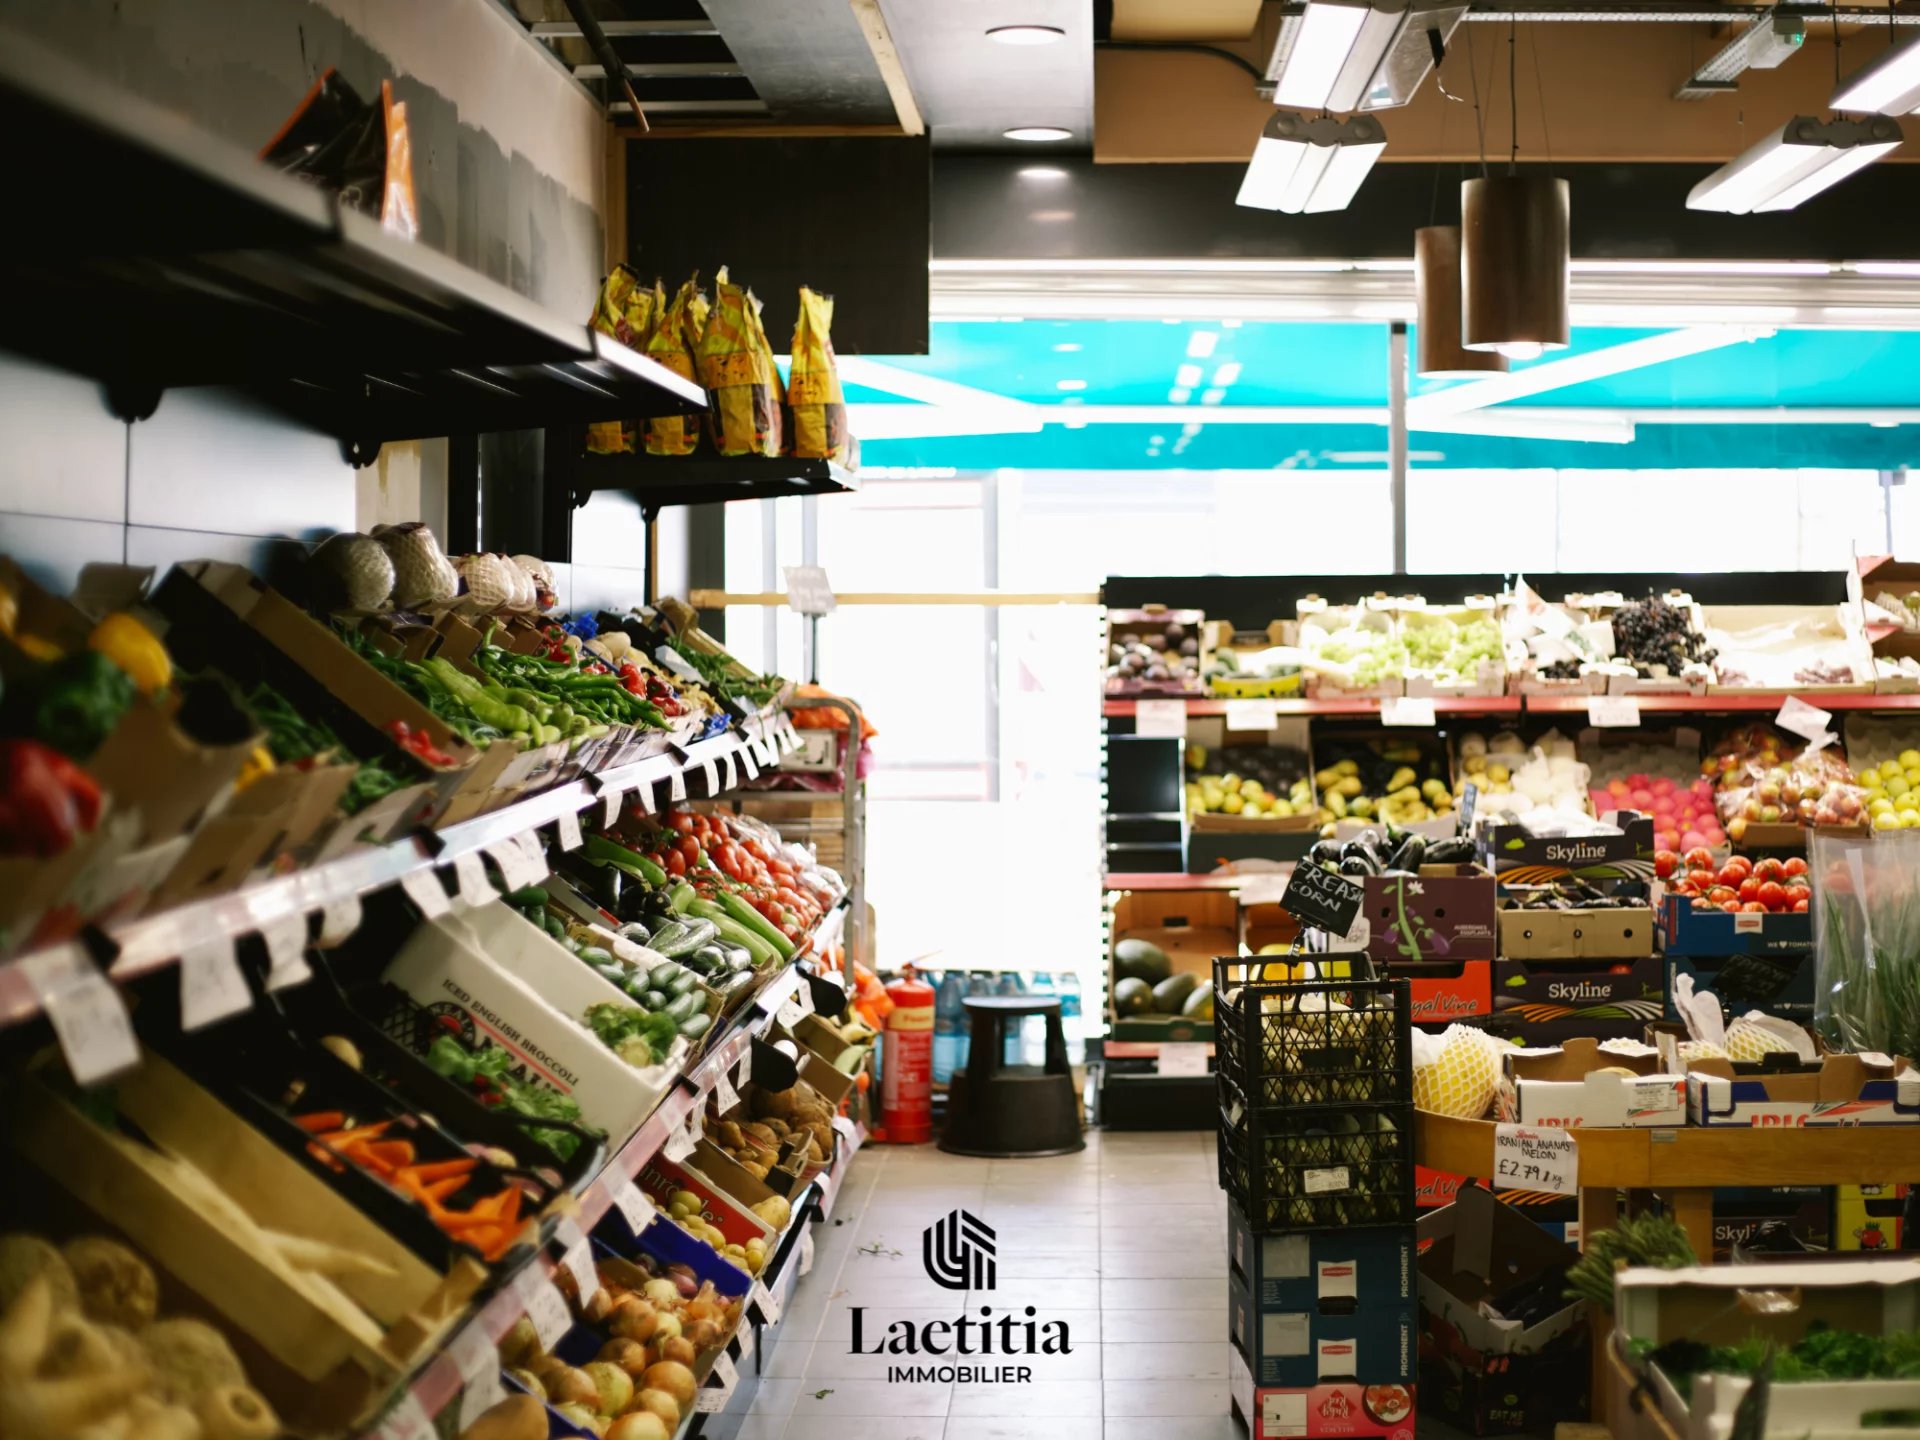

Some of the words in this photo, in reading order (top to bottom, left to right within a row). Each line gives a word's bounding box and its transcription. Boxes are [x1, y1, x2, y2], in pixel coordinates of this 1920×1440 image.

[1546, 842, 1607, 862] Skyline
[1297, 860, 1364, 902] FREASH
[1289, 881, 1342, 911] CORN
[1411, 992, 1442, 1017] yal
[1442, 994, 1477, 1010] Vine
[1549, 980, 1611, 1002] Skyline
[442, 979, 471, 1003] ICED
[470, 1001, 521, 1042] ENGLISH
[520, 1039, 579, 1086] BROCCOLI
[1497, 1135, 1533, 1149] IRANIAN
[1536, 1140, 1571, 1152] ANANAS
[1521, 1148, 1557, 1160] MELON
[1401, 1245, 1409, 1298] PROMINENT
[1401, 1324, 1409, 1377] PROMINENT
